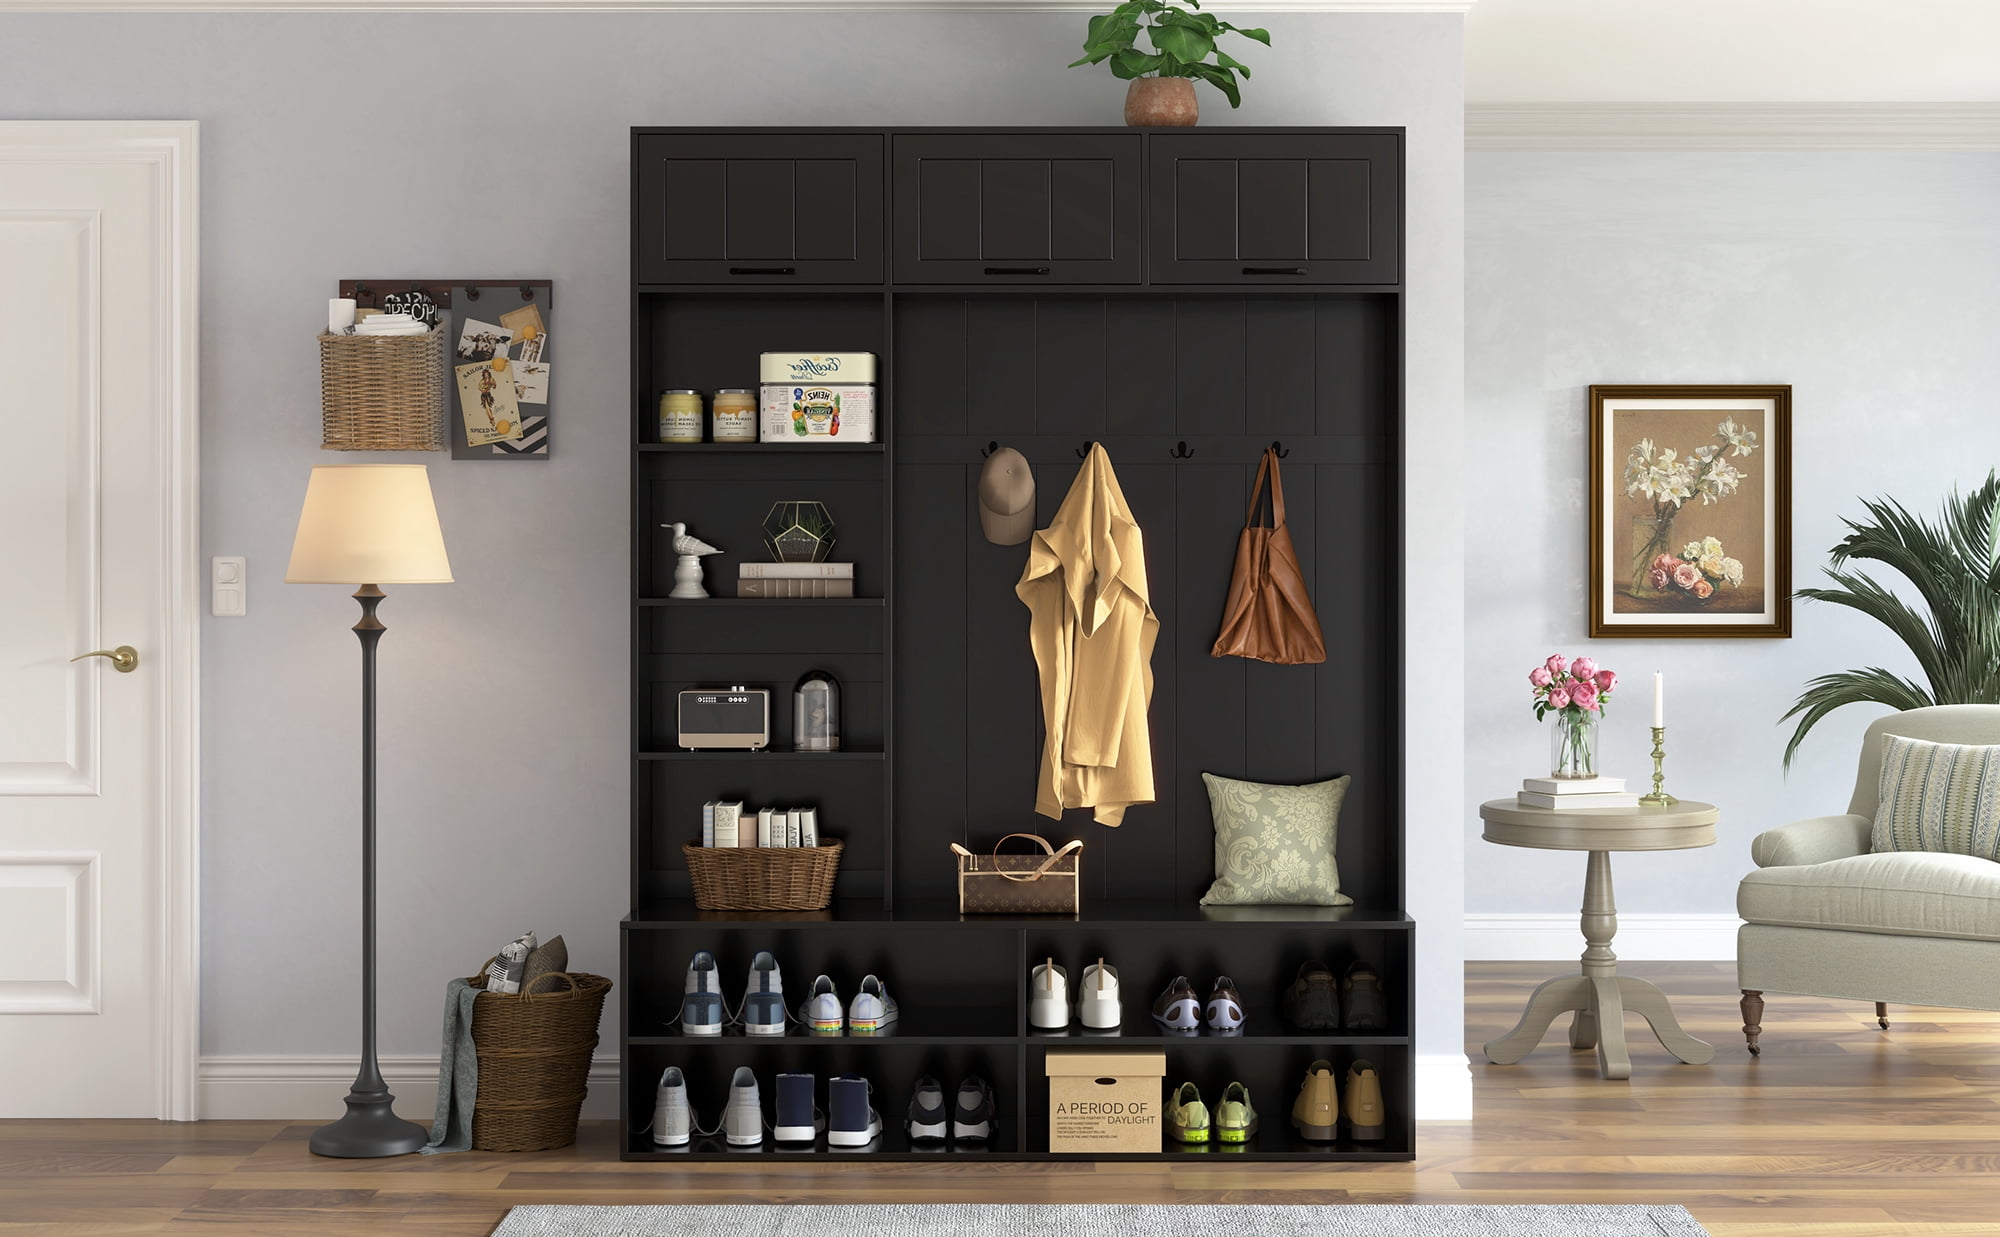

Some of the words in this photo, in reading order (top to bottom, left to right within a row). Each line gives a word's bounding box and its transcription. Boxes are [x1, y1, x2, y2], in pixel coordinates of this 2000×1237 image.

[1056, 1103, 1067, 1114] A
[1070, 1103, 1124, 1114] PERIOD
[1128, 1103, 1148, 1114] OF
[1107, 1116, 1156, 1124] DAYLIGHT
